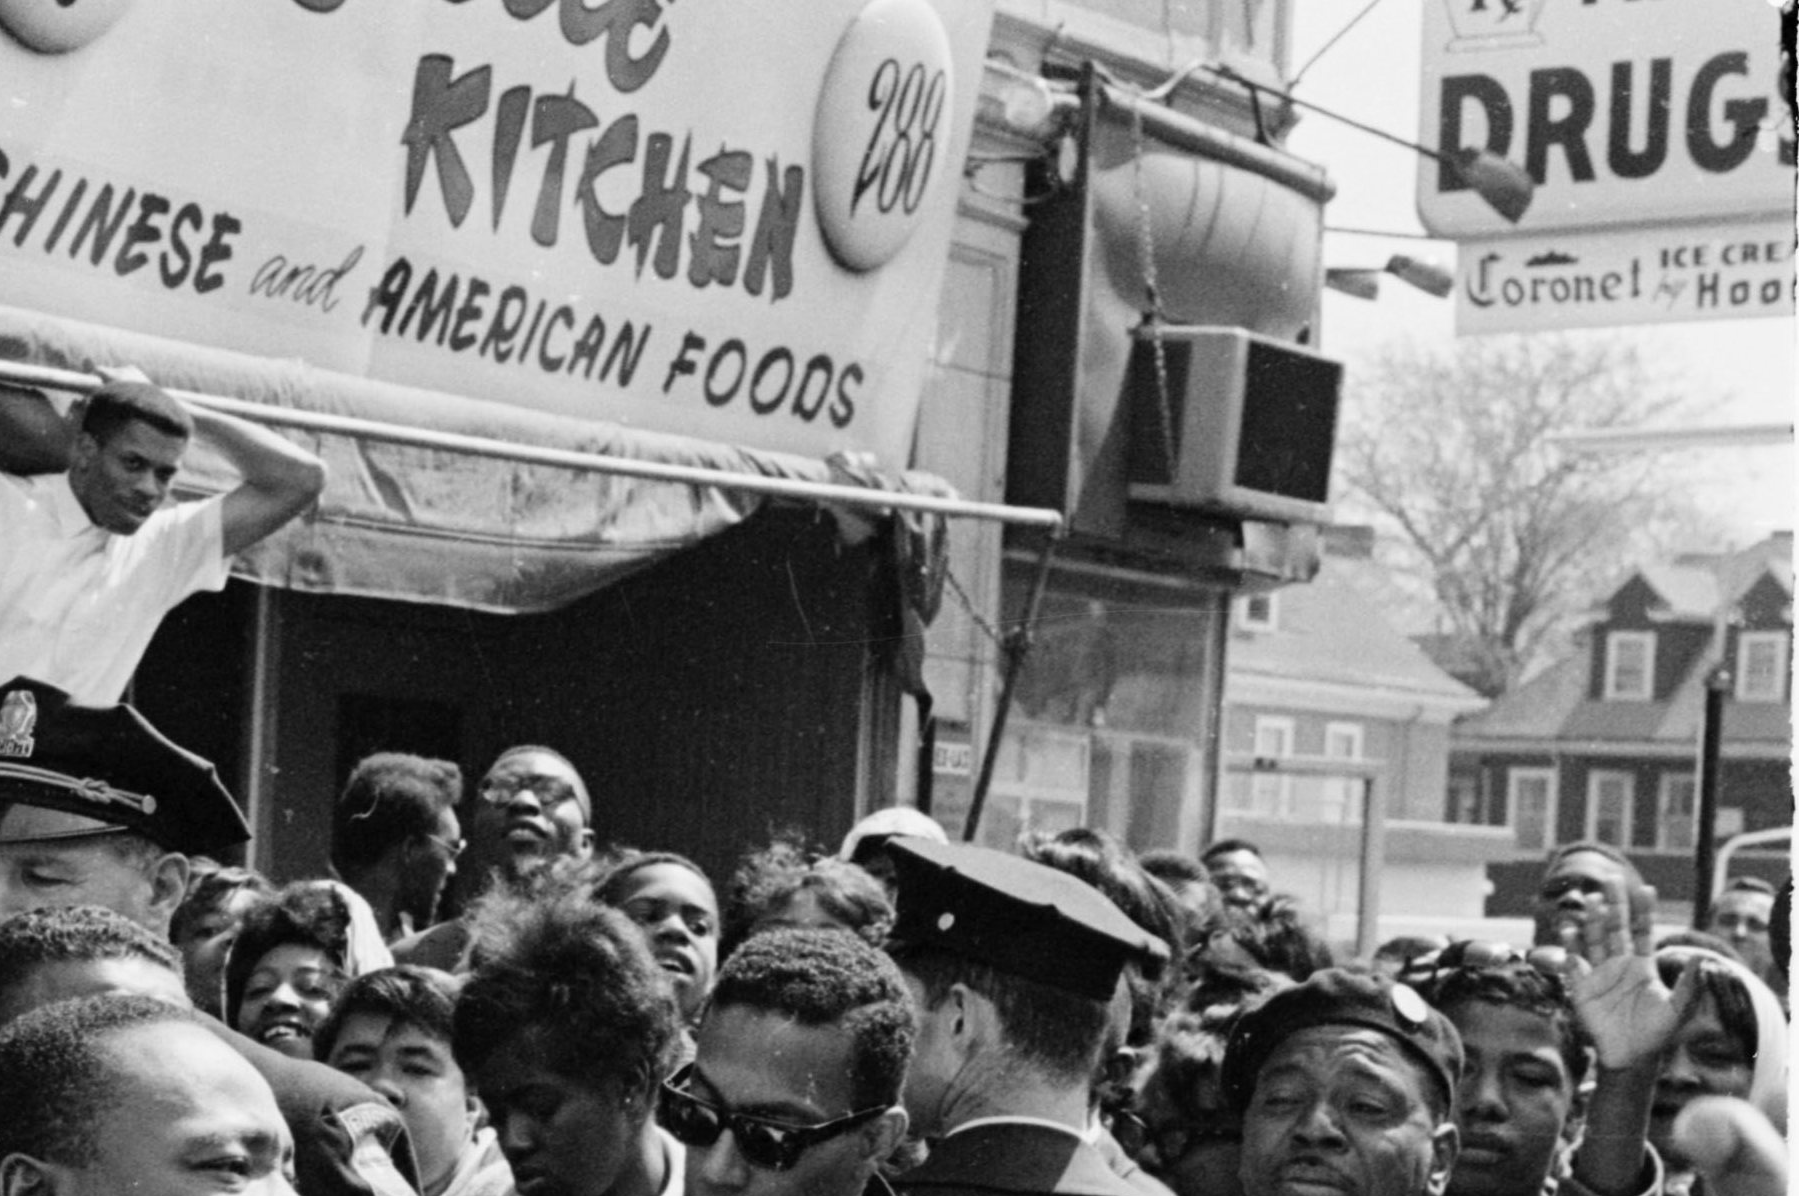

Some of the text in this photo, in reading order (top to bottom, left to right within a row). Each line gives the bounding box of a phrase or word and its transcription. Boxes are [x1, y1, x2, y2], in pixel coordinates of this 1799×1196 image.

[401, 52, 805, 301] KITCHEN
[852, 57, 946, 219] 288
[1438, 51, 1798, 192] DRUG
[1660, 241, 1796, 269] ICE CRE
[1697, 272, 1796, 308] Hoo
[249, 244, 365, 313] and
[360, 257, 652, 389] AMERICAN
[662, 331, 864, 428] FOODS
